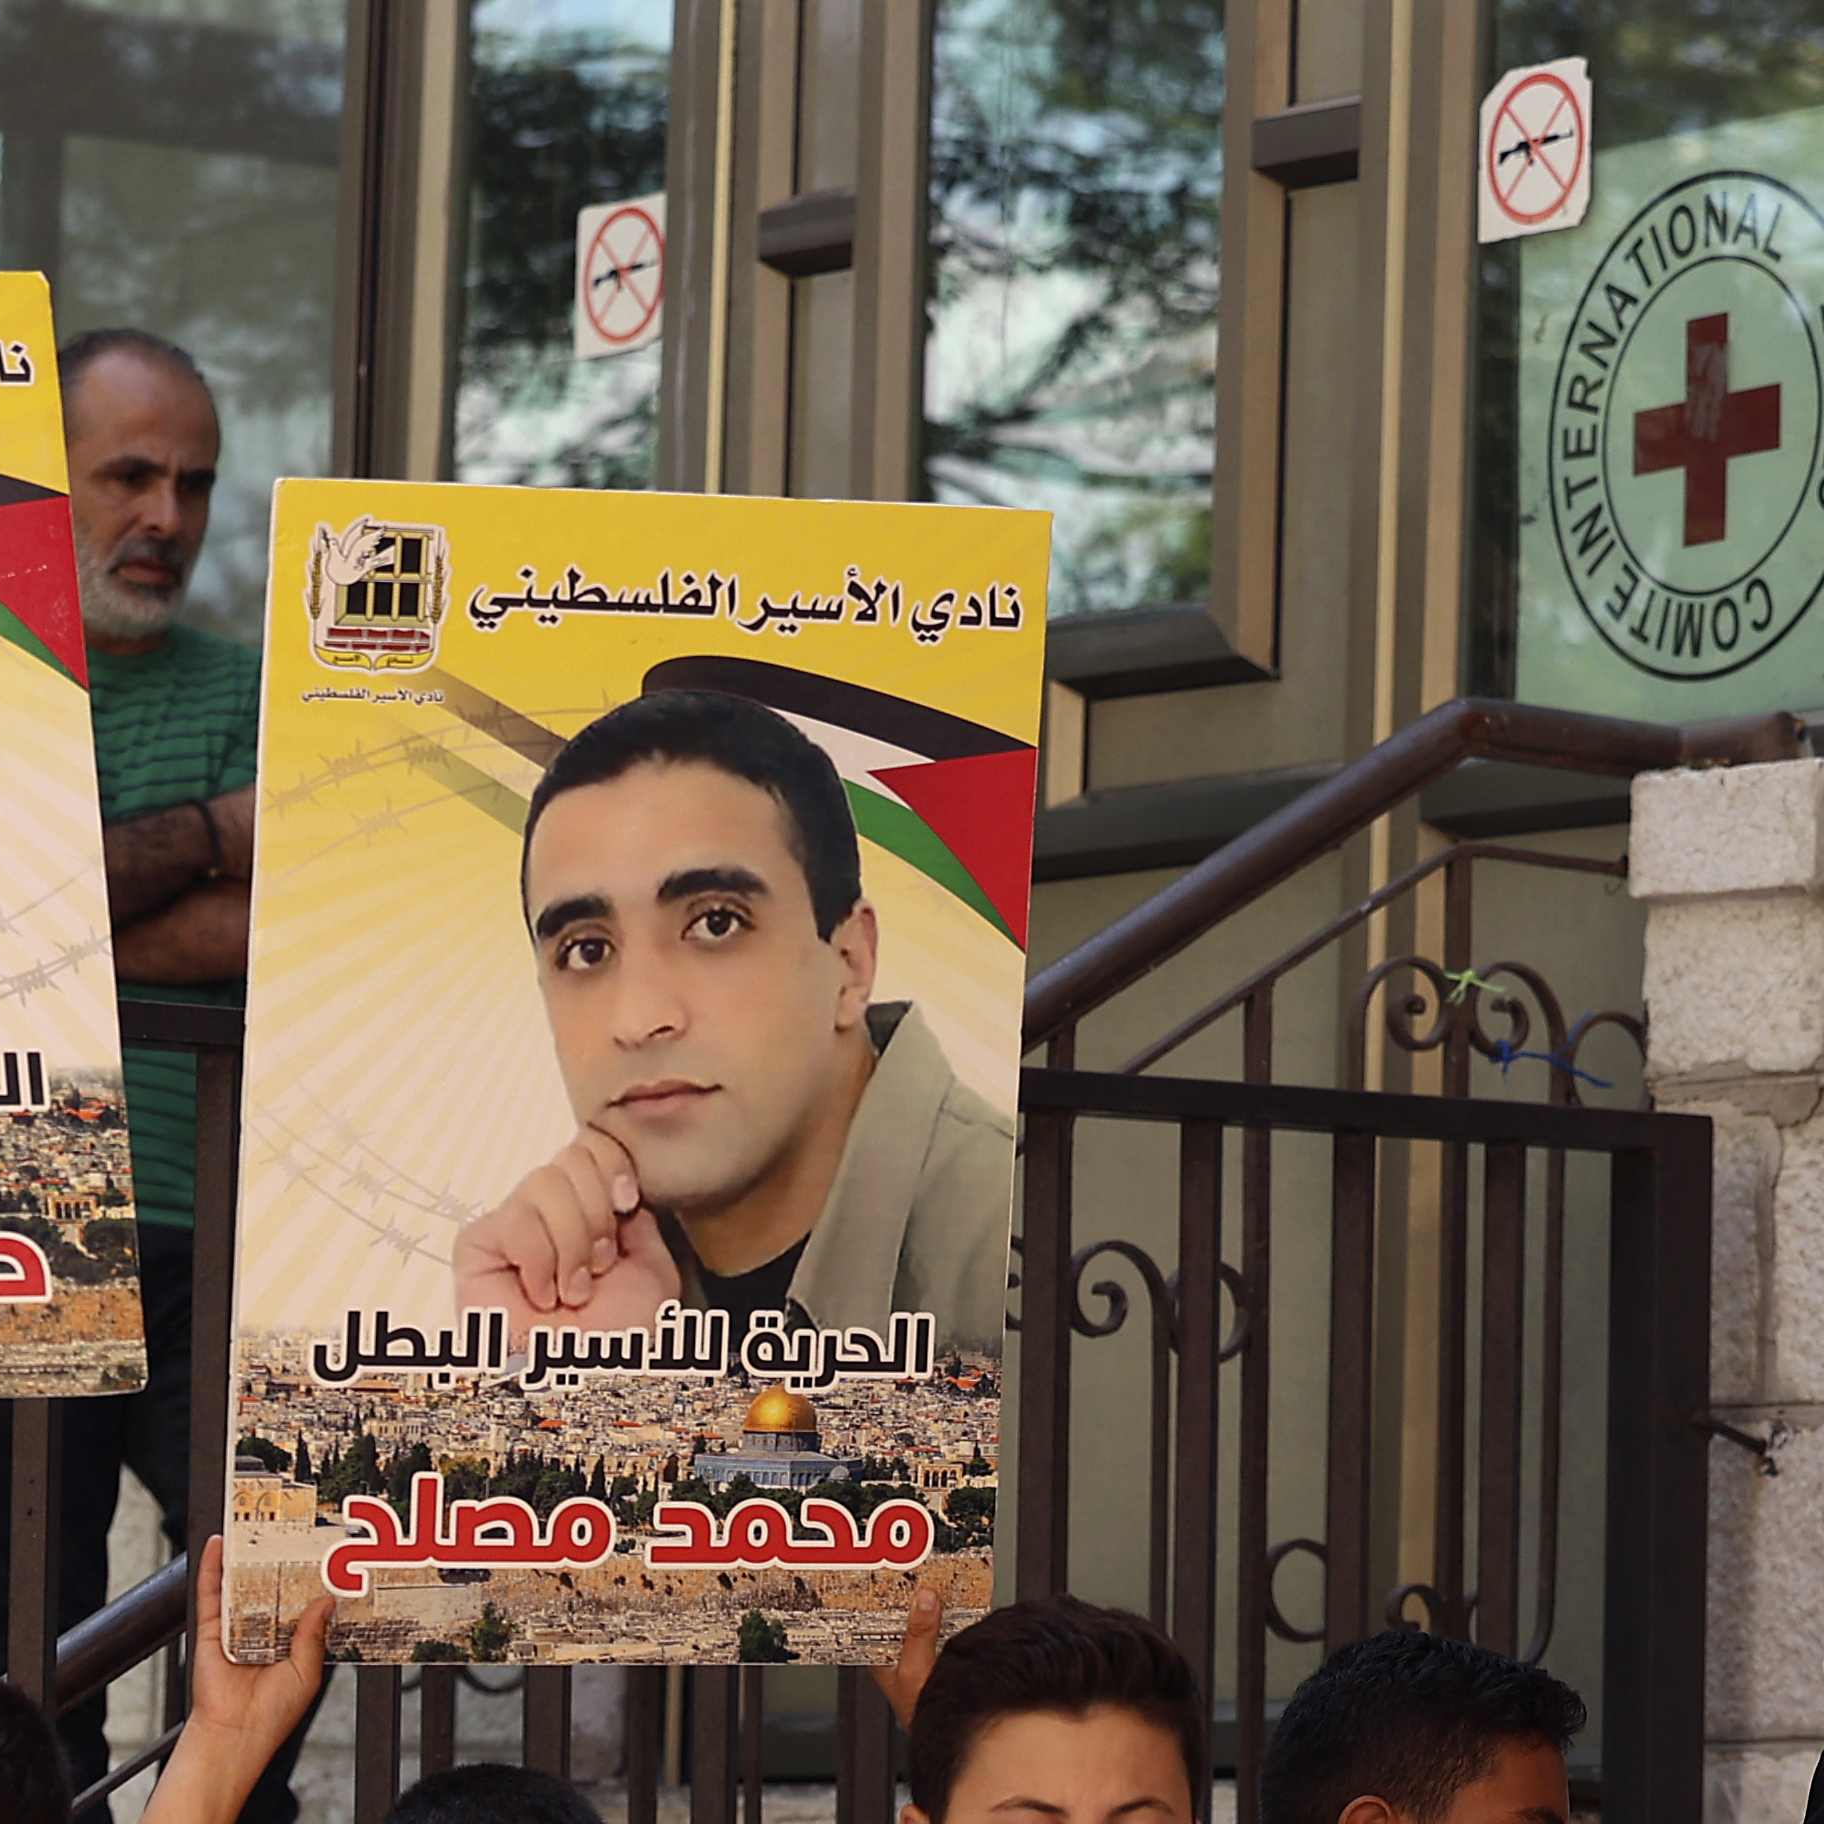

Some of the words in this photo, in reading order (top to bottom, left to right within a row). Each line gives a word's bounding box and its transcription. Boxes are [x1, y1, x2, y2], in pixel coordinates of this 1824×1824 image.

[1563, 193, 1784, 577] INTERNATIONAL
[470, 568, 736, 631] الفلسطيني
[736, 566, 898, 635] الأسير
[911, 585, 1021, 645] نادي
[1605, 563, 1773, 658] COMITE
[316, 1311, 503, 1385] البطل
[530, 1302, 725, 1385] للأسير
[748, 1312, 931, 1388] الحرية
[329, 1477, 612, 1592] مصلح
[651, 1504, 930, 1564] محمد
